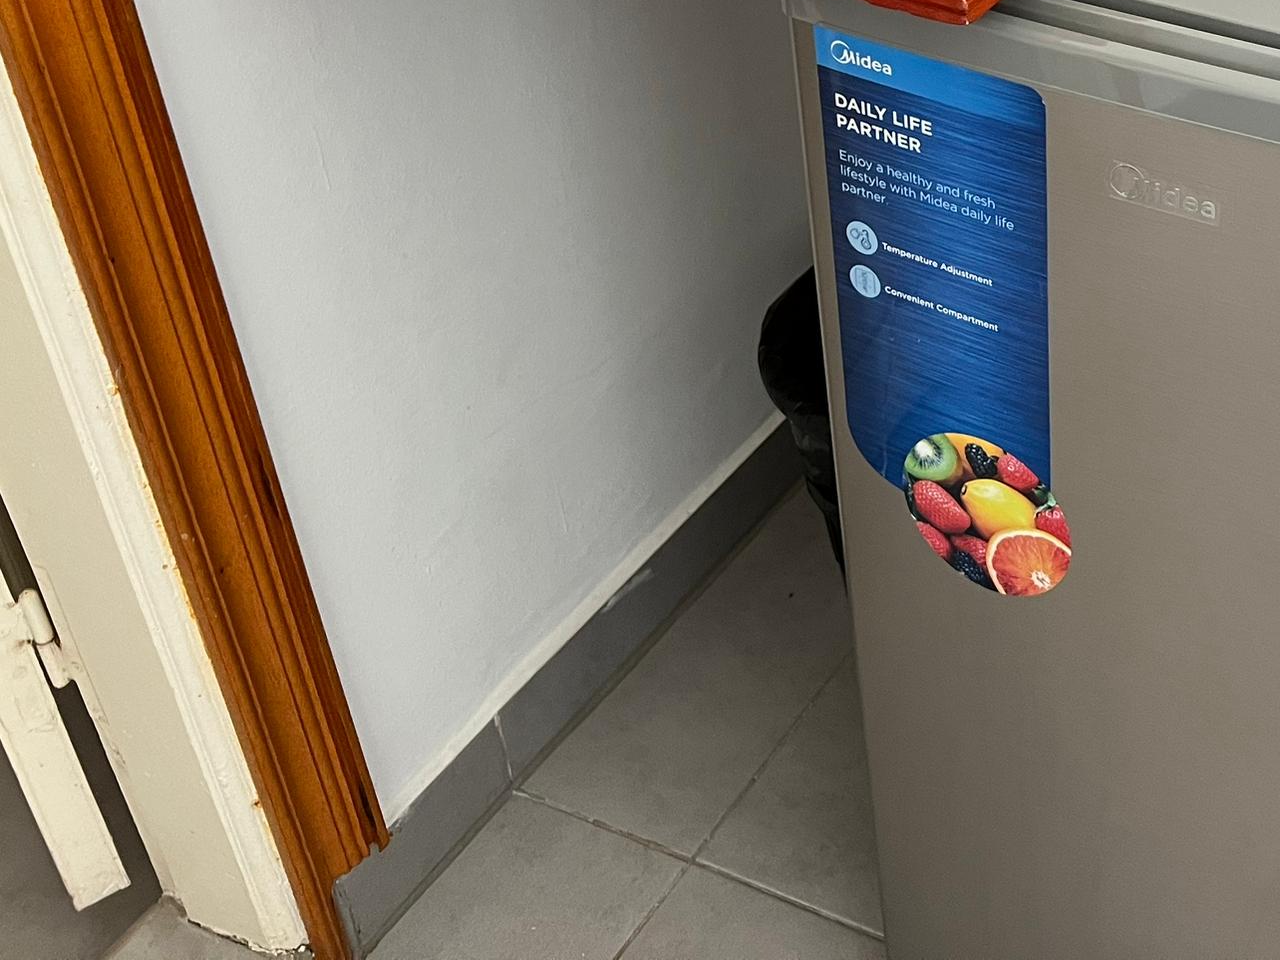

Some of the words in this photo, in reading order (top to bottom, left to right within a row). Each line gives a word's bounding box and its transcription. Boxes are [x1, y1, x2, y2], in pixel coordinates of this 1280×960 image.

[831, 40, 893, 76] Midea
[834, 92, 887, 121] DAILY
[892, 110, 933, 137] LIFE
[836, 113, 921, 153] PARTNER
[839, 149, 873, 171] Enjoy
[876, 164, 884, 173] a
[886, 165, 933, 190] healthy
[936, 182, 961, 198] and
[964, 191, 996, 210] fresh
[840, 165, 887, 189] lifestyle
[890, 183, 917, 199] with
[920, 191, 958, 213] Midea
[961, 205, 992, 225] daily
[995, 215, 1015, 231] life
[1108, 163, 1217, 219] Midea
[881, 242, 939, 268] Temperature
[940, 262, 993, 287] Adjustment
[884, 285, 935, 310] Convenient
[936, 304, 999, 332] Compartment
